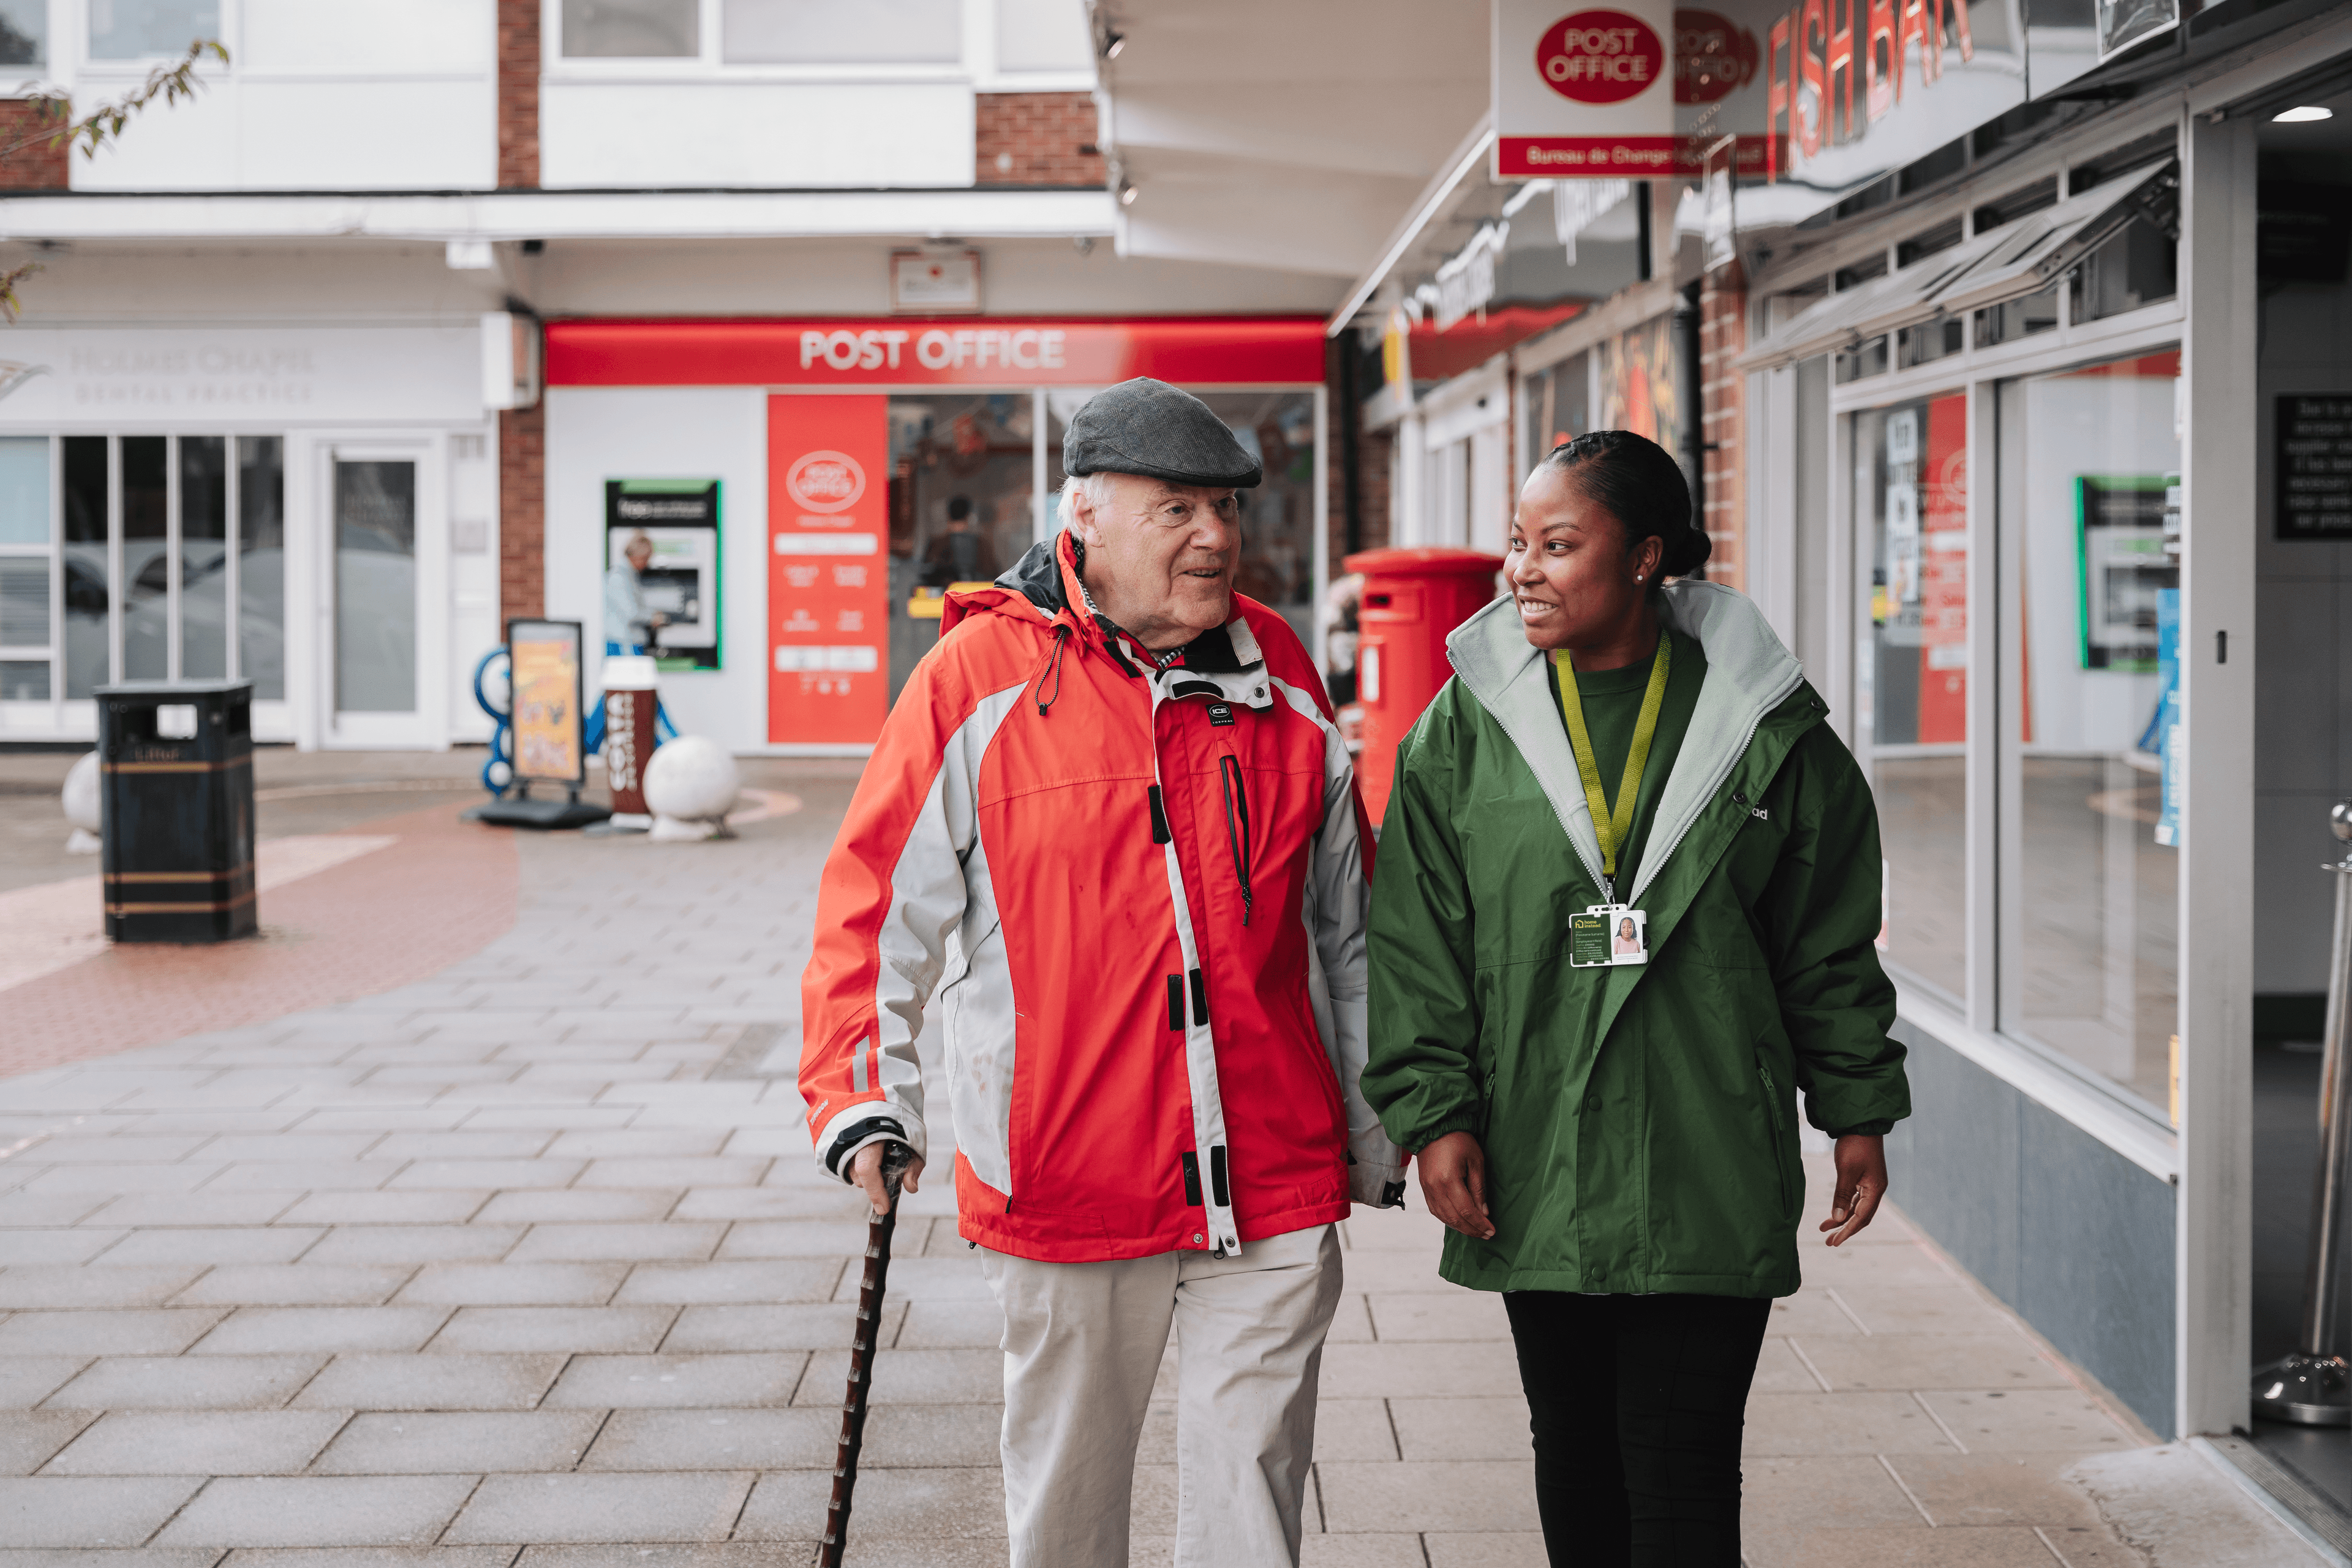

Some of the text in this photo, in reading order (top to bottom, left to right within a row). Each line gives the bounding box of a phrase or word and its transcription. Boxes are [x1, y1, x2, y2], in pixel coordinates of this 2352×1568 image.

[1564, 28, 1639, 55] POST
[1545, 55, 1650, 82] OFFICE
[1766, 0, 1855, 184] FISH
[1527, 146, 1586, 165] Bureau
[1588, 147, 1610, 165] de
[1611, 145, 1672, 167] Change
[799, 329, 1065, 371] POST OFFICE
